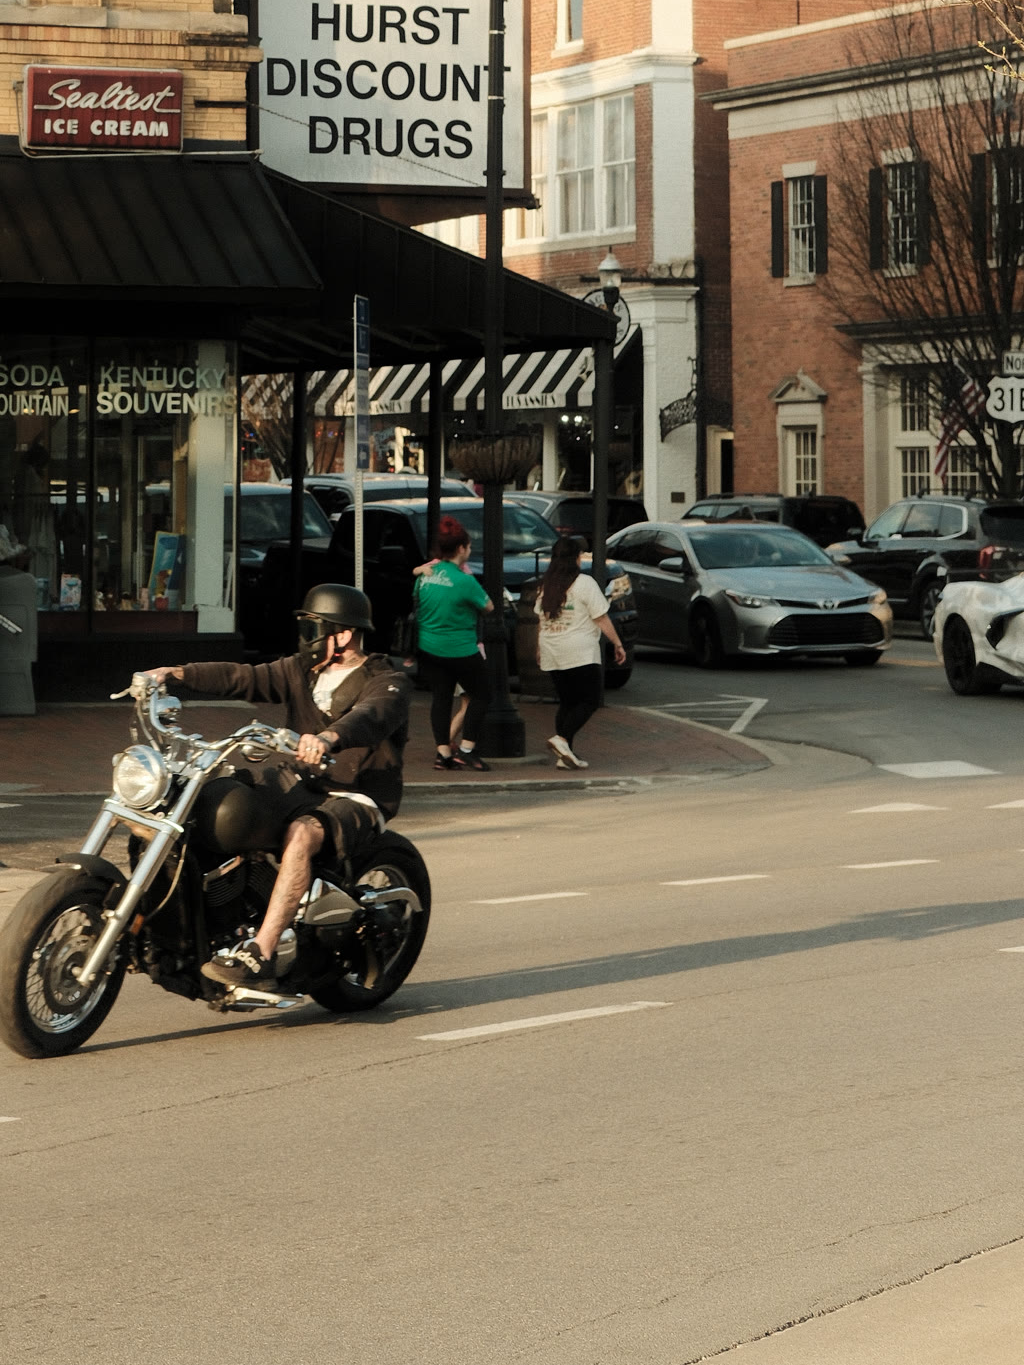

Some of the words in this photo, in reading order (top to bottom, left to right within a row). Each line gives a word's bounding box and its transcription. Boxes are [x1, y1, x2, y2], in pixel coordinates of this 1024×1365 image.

[311, 2, 470, 45] HURST
[266, 57, 511, 102] DISCOUN
[33, 78, 181, 113] Sealtest
[43, 118, 79, 135] ICE
[89, 119, 170, 137] CREAM
[308, 115, 473, 159] DRUGS
[100, 365, 227, 389] KENTUCKY
[1005, 355, 1024, 371] NO
[95, 391, 237, 416] SOUVENIRS
